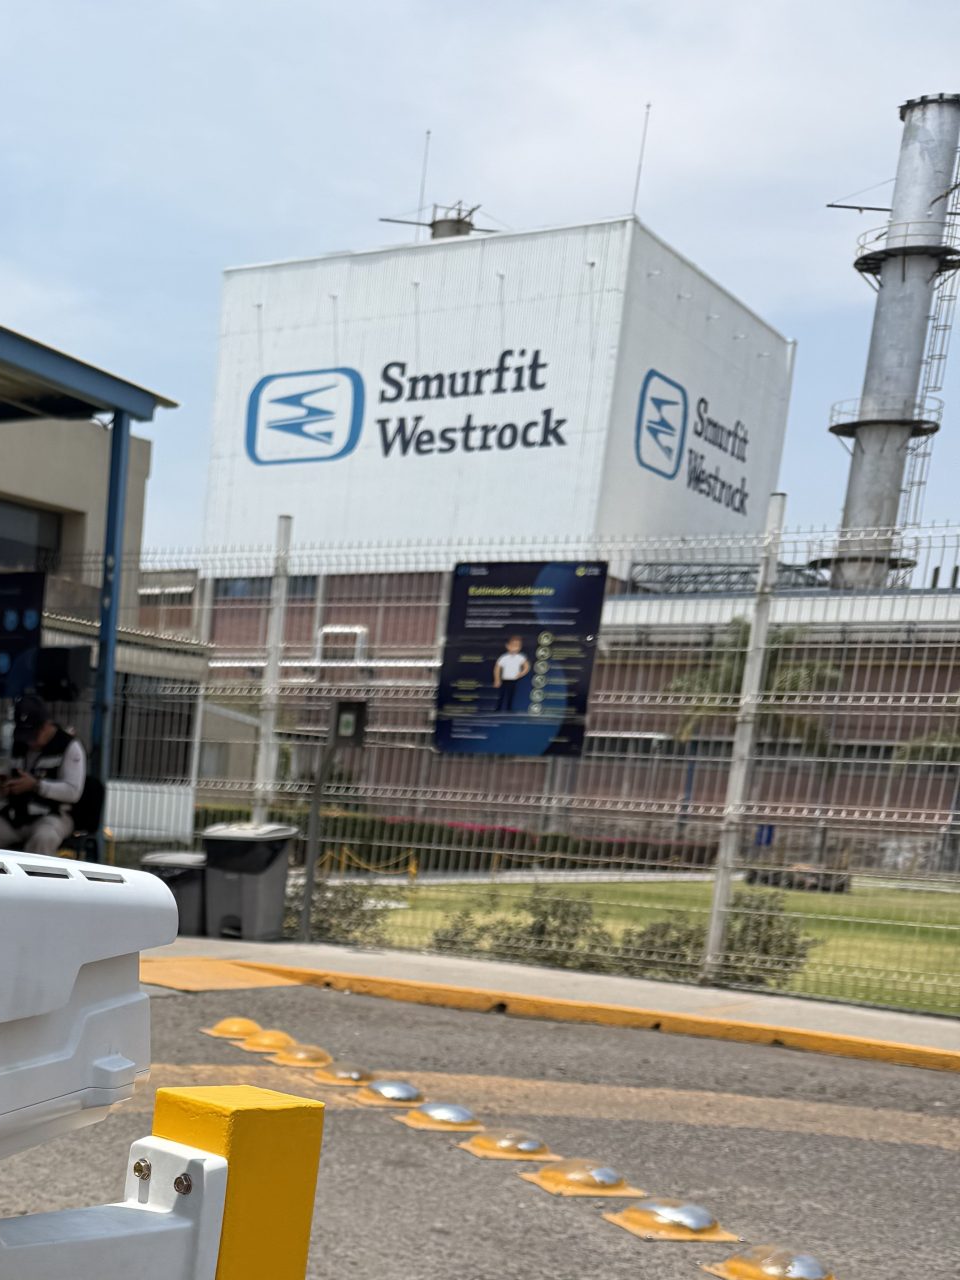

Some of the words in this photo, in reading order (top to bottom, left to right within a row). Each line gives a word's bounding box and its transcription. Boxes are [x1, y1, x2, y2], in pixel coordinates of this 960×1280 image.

[378, 348, 550, 404] Smurfit
[376, 408, 568, 458] Westrock
[693, 397, 749, 463] Smurfit
[687, 448, 749, 516] Westrock
